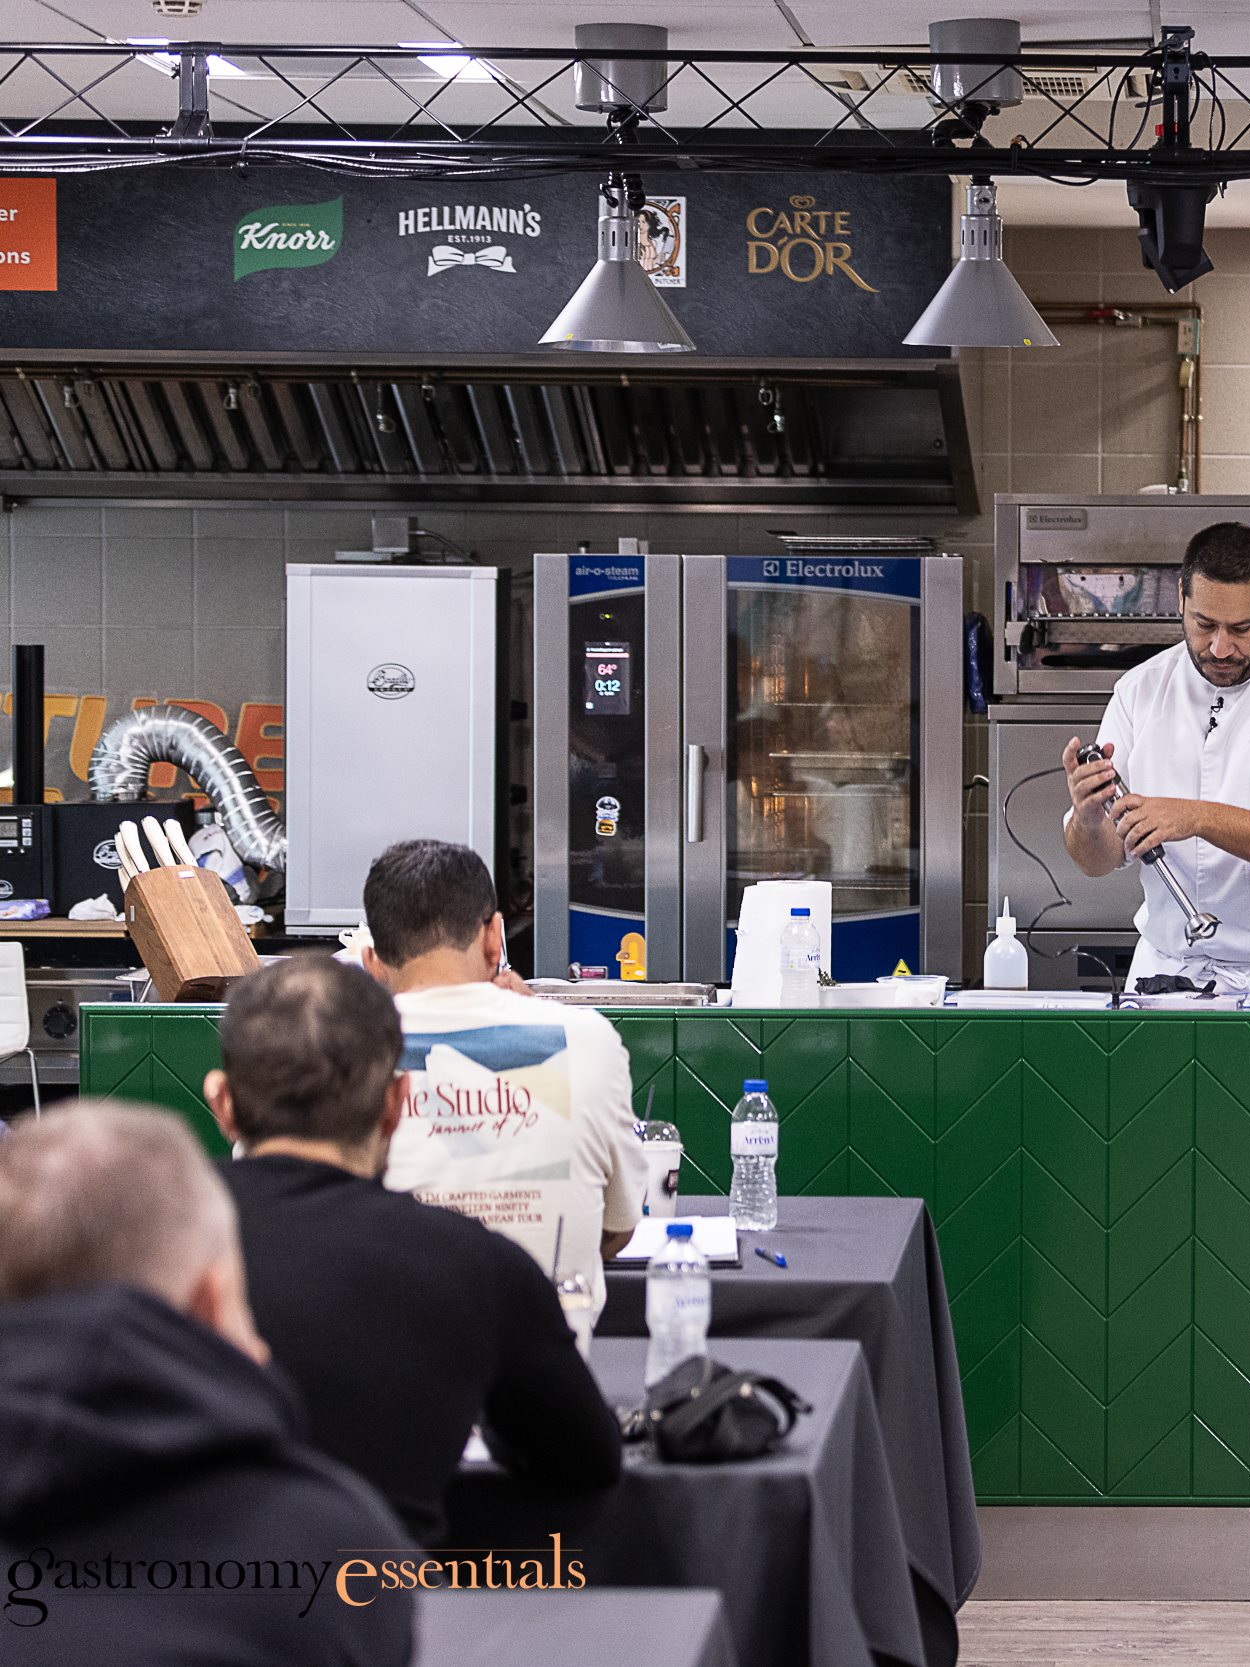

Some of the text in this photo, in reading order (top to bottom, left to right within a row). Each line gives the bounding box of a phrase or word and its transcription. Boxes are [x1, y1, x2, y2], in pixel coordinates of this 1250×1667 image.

[398, 203, 541, 237] HELLMANN'S
[746, 207, 851, 240] CARTE
[238, 222, 336, 250] Knorr
[747, 236, 880, 293] D'OR
[575, 565, 639, 576] air-o-steam
[786, 560, 884, 577] Electrolux
[436, 1077, 531, 1117] Studio
[491, 1190, 541, 1200] GARMENTS
[447, 1203, 491, 1214] INETEEN
[517, 1213, 543, 1223] TOUR
